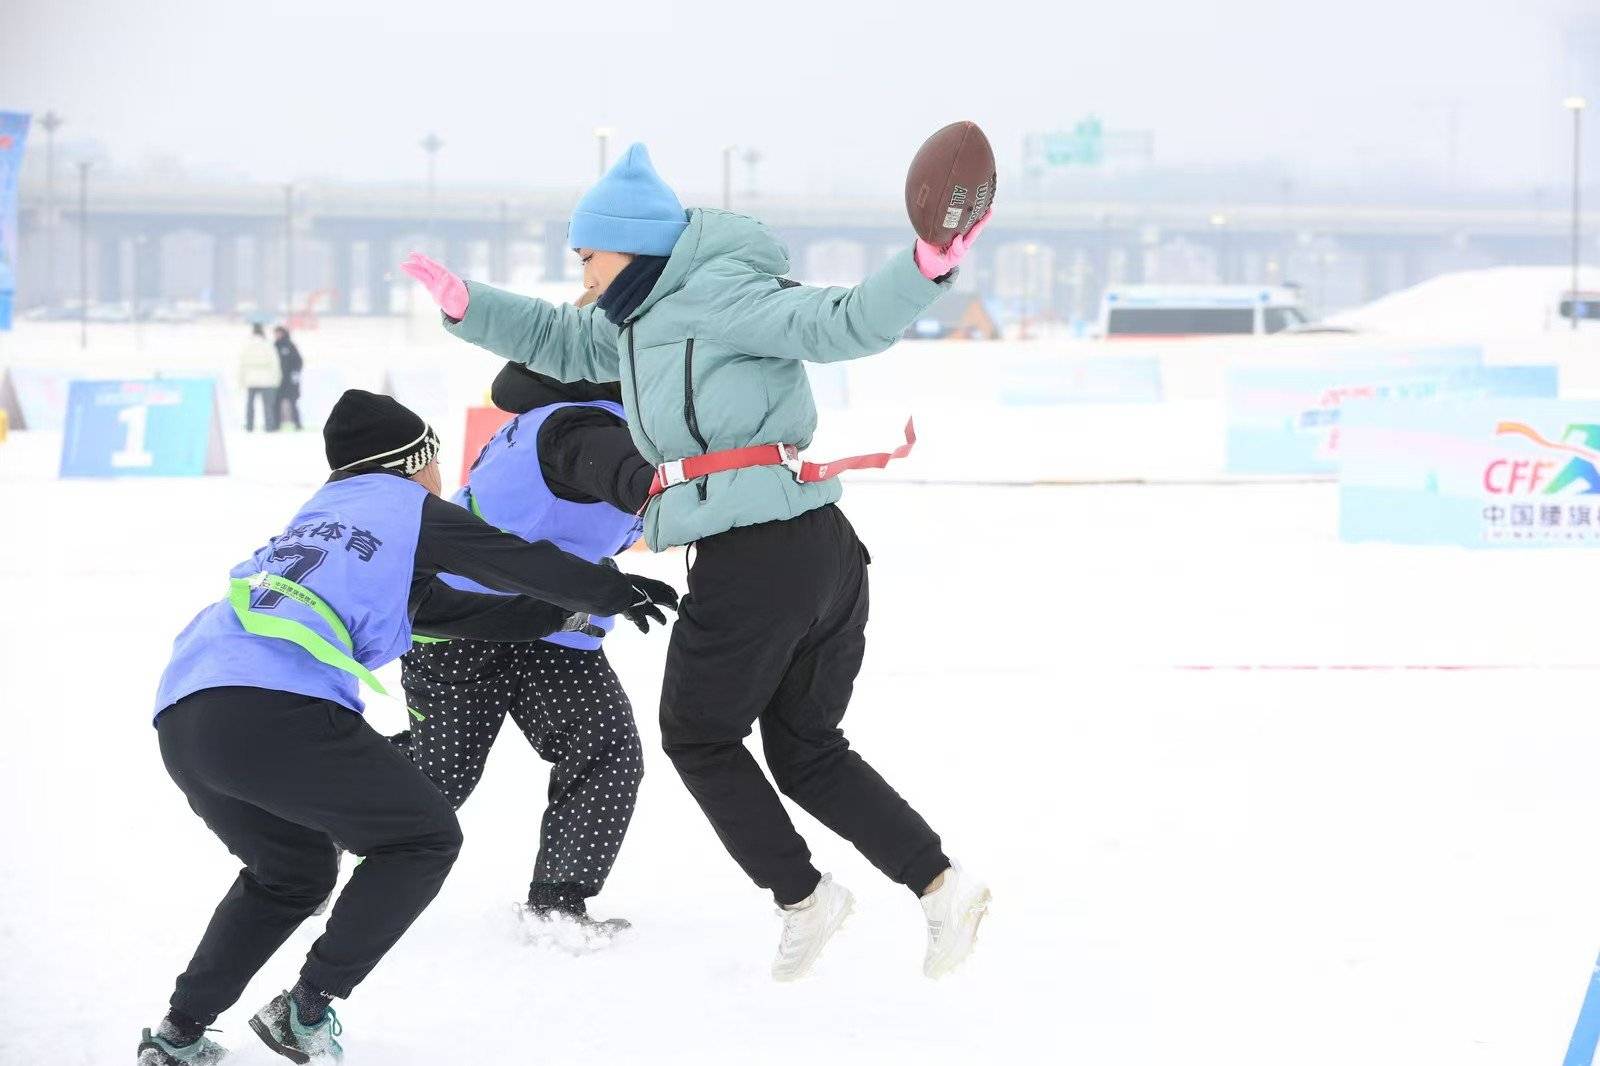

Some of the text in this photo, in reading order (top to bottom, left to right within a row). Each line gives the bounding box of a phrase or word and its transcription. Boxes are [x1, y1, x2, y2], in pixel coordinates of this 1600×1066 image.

[950, 185, 967, 207] ALL
[111, 406, 153, 467] 1
[1483, 503, 1600, 527] 中国腰旗
[252, 542, 329, 609] 7
